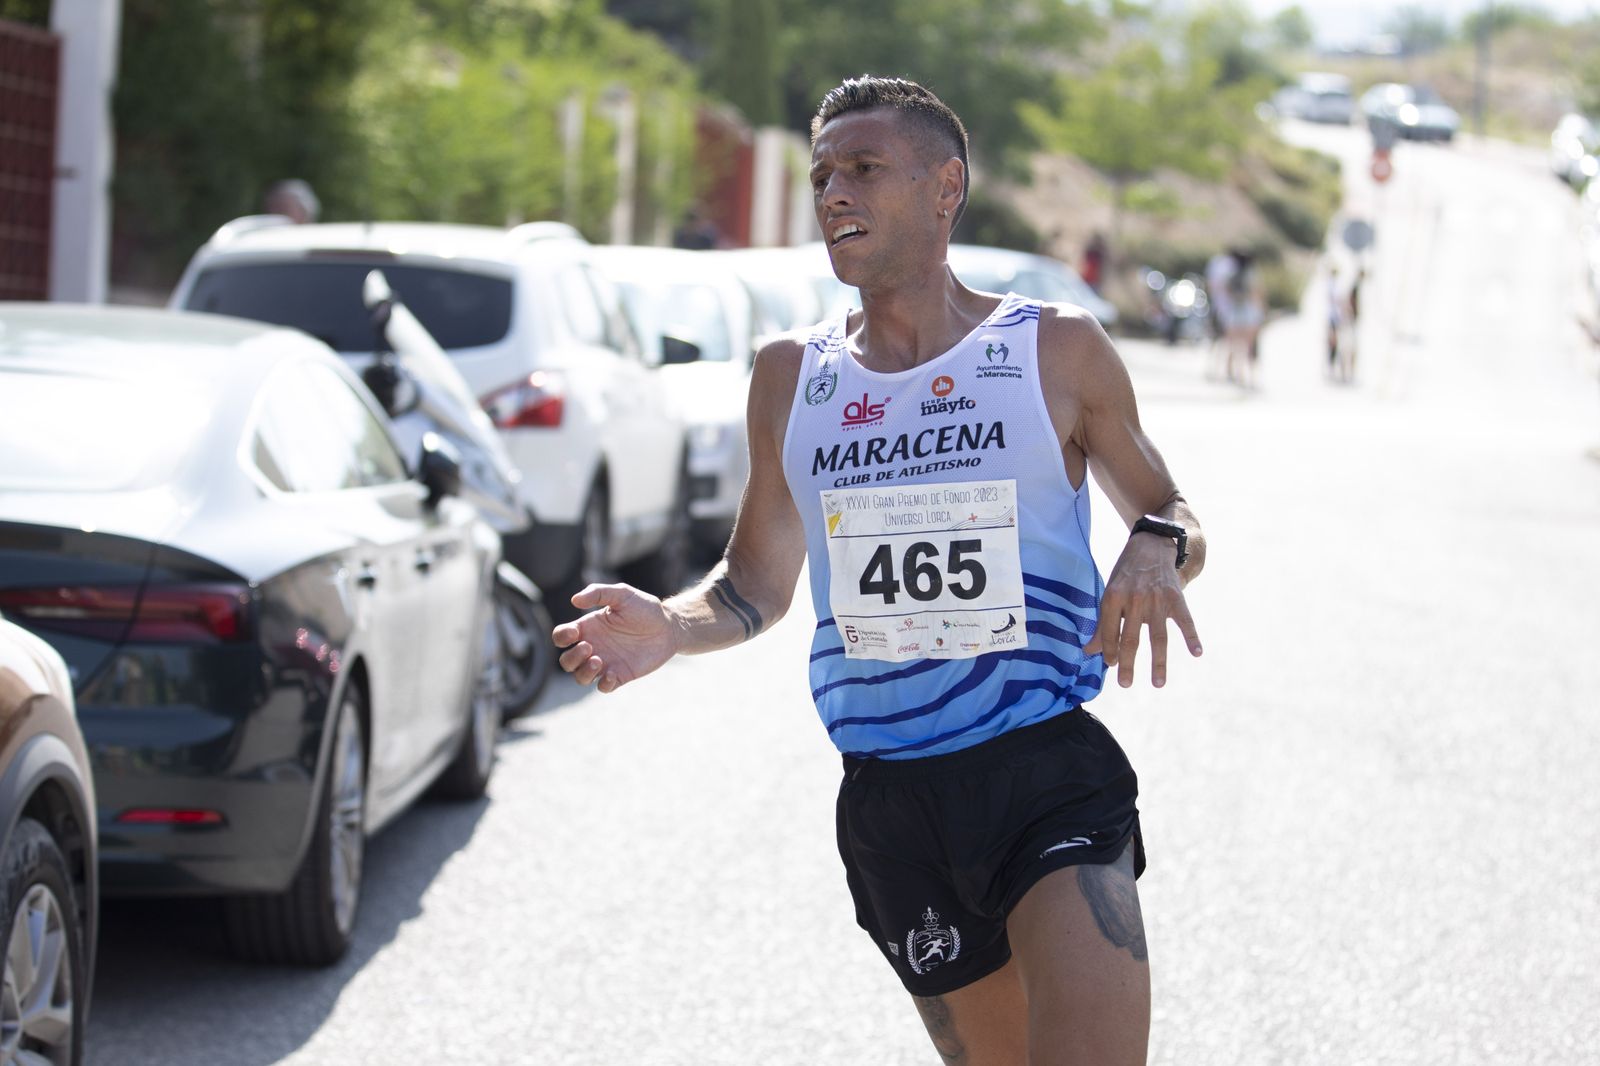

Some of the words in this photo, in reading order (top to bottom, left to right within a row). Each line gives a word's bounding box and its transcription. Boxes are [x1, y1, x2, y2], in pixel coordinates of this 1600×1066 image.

[976, 364, 1022, 372] Ayuntamiento
[984, 371, 1022, 379] Maracena
[920, 396, 976, 416] mayfo
[811, 421, 1006, 476] MARACENA
[833, 473, 871, 488] CLUB
[875, 470, 895, 482] DE
[898, 457, 982, 478] ATLETISMO
[846, 495, 870, 511] XXXVI
[974, 487, 999, 503] 2023
[859, 539, 987, 605] 465
